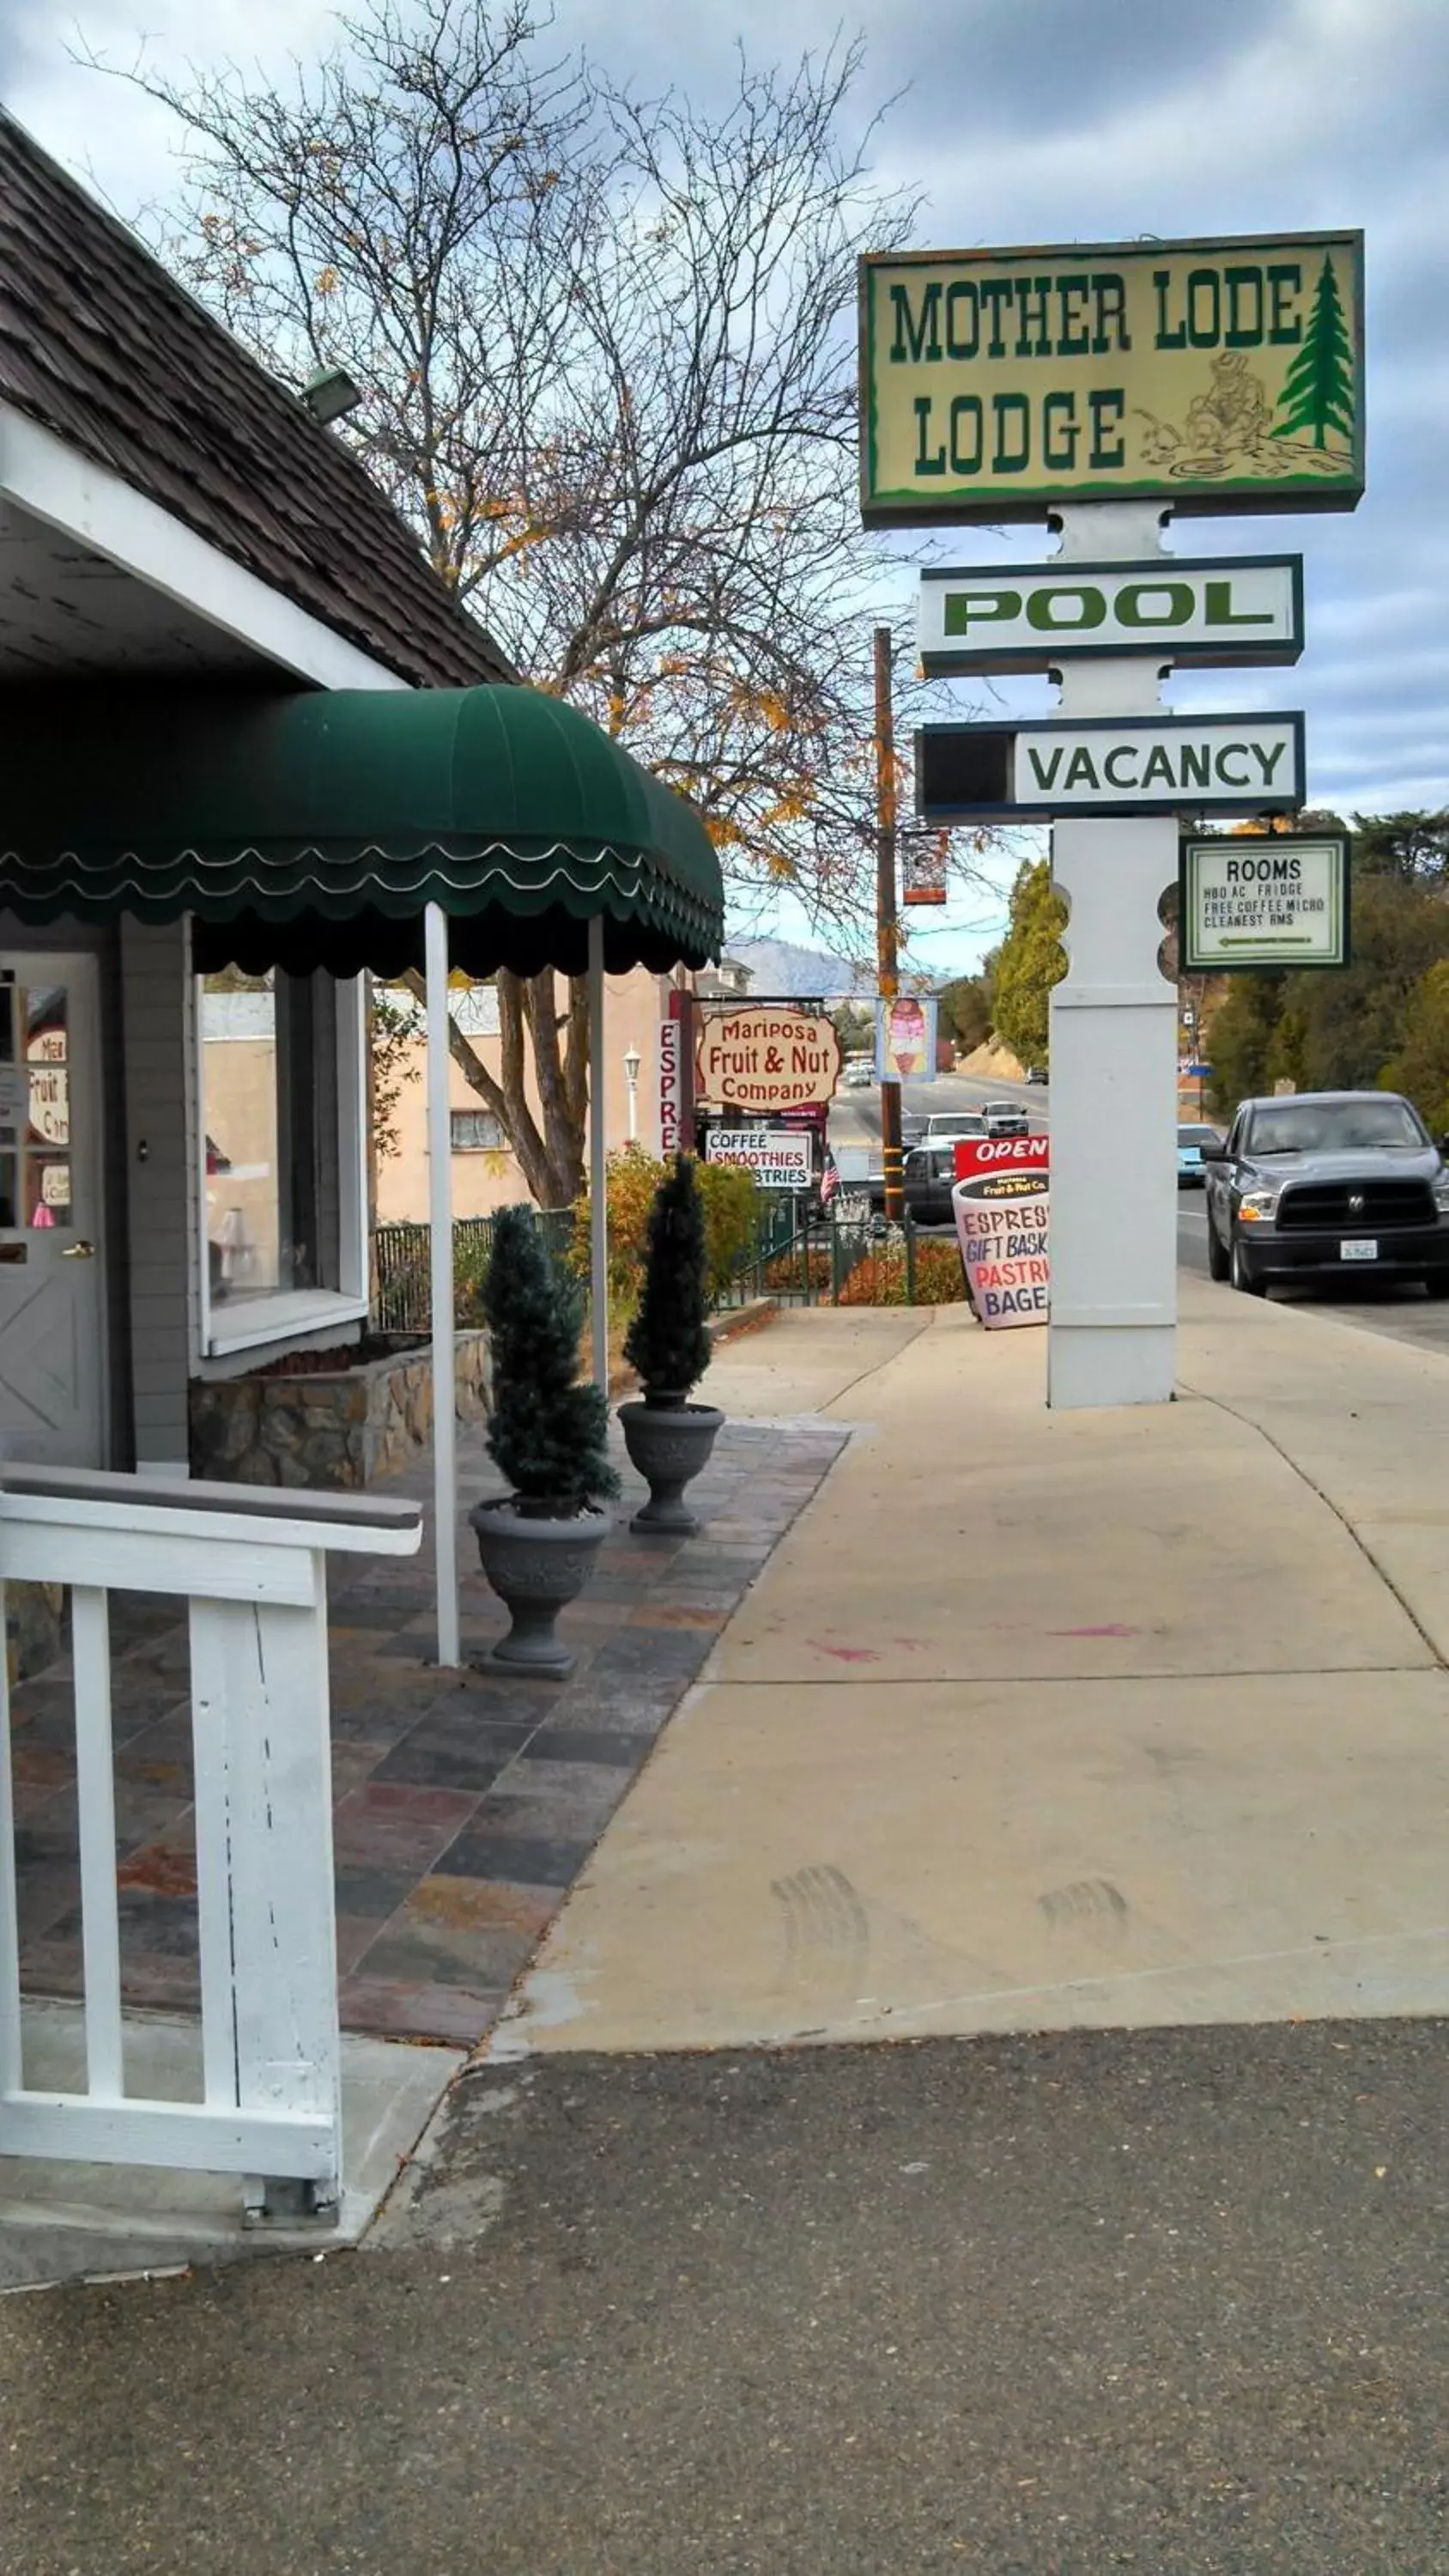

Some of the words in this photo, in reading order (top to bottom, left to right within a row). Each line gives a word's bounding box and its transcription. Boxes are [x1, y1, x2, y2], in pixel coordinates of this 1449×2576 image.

[889, 273, 1131, 363] MOTHER
[1153, 264, 1302, 350] LODE
[914, 388, 1125, 476] LODGE
[944, 581, 1275, 635] POOL
[1028, 743, 1287, 791] VACANCY
[1227, 859, 1301, 882] ROOMS
[1203, 886, 1227, 899] HBO
[1232, 885, 1246, 897] AC
[1258, 883, 1302, 896] FRIDGE
[1204, 902, 1233, 914] FREE
[1237, 900, 1282, 913] COFFEE
[1286, 898, 1325, 912] MICRO
[1203, 914, 1263, 928] CLEANEST
[1270, 913, 1294, 926] RMS
[723, 1018, 817, 1042] Mariposa
[710, 1046, 759, 1073] Fruit
[765, 1046, 785, 1073] &
[792, 1046, 830, 1073] Nut
[722, 1078, 816, 1100] Company
[711, 1134, 767, 1148] COFFEE
[976, 1139, 1047, 1161] OPEN
[715, 1151, 804, 1166] SMOOTHIES
[967, 1236, 1003, 1262] GIFT
[1006, 1232, 1047, 1258] BASK
